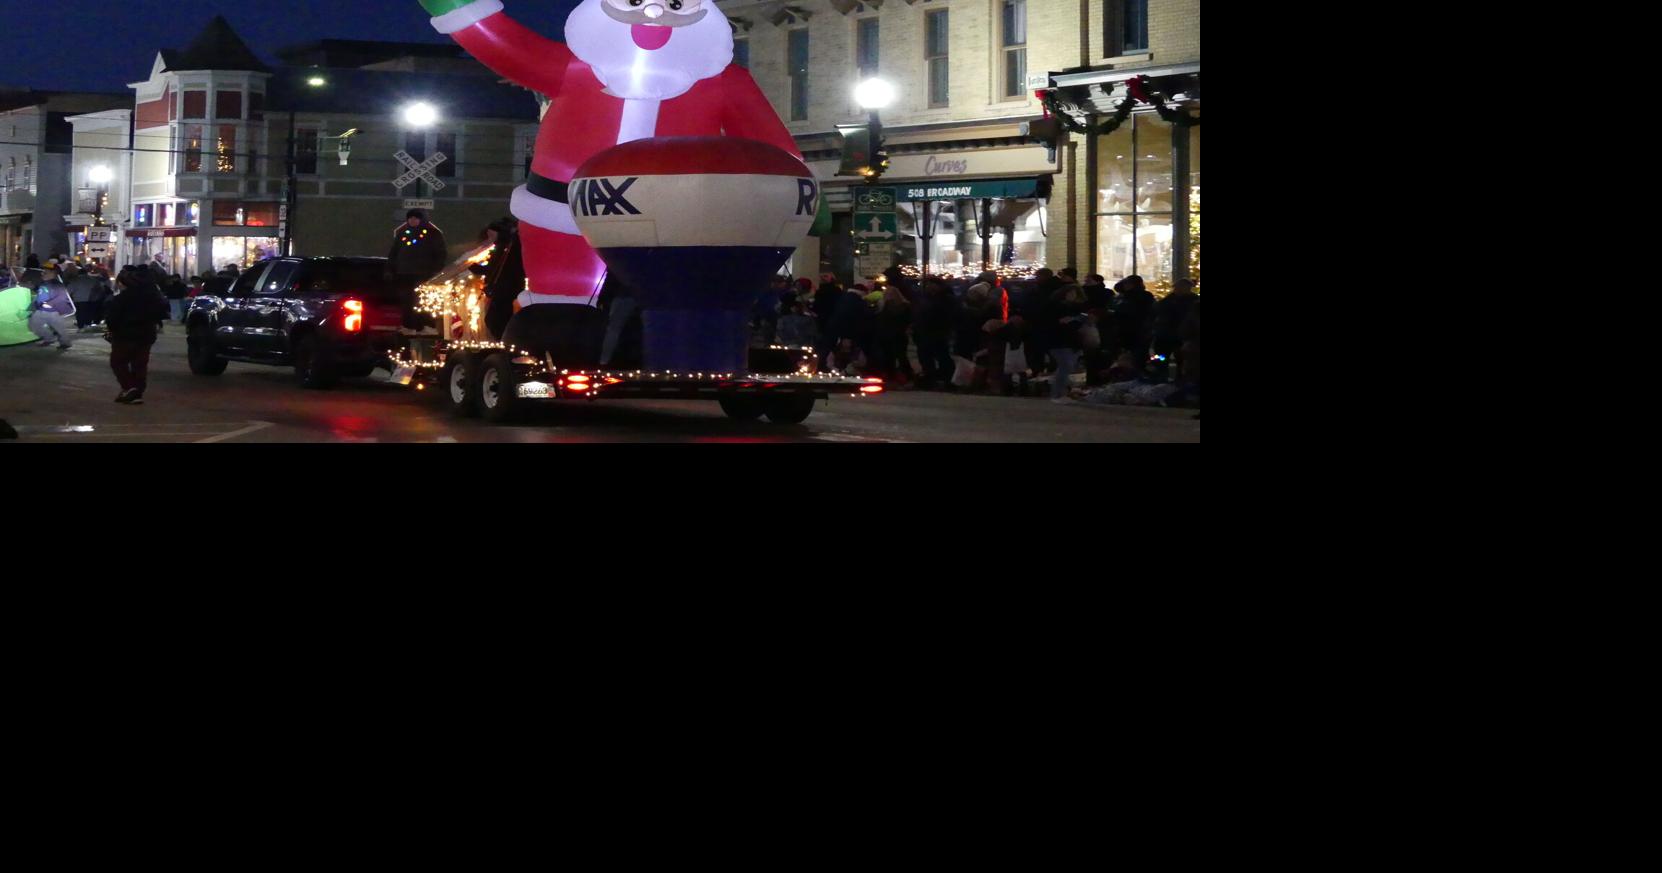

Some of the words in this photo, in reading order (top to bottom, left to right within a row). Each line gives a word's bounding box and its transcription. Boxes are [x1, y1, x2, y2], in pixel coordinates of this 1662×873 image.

[925, 155, 967, 176] Curves
[795, 178, 815, 215] R
[908, 188, 925, 198] 508
[927, 186, 972, 197] BROADWAY
[90, 231, 107, 240] PP
